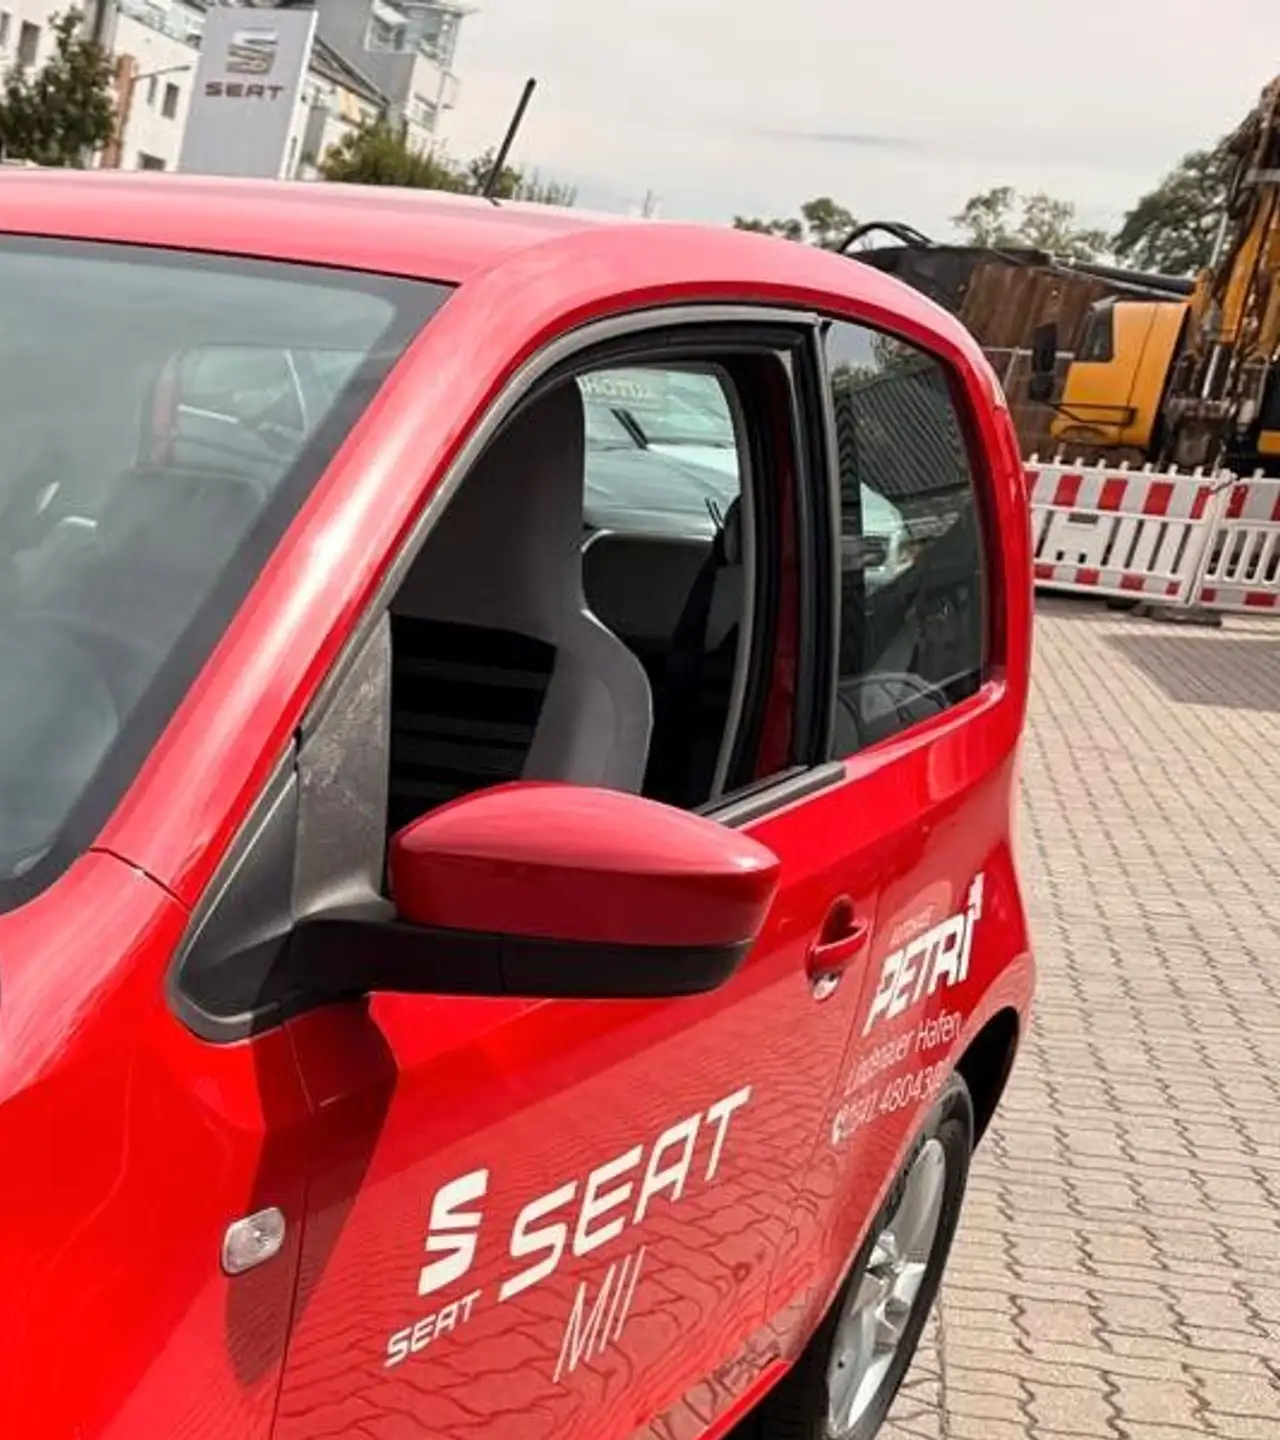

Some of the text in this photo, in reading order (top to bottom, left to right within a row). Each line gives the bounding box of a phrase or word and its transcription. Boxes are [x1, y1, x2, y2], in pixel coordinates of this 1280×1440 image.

[205, 81, 284, 101] SEAT
[861, 872, 984, 1037] PETRI
[915, 1008, 963, 1053] Hafen
[499, 1085, 752, 1302] SEAT
[384, 1288, 483, 1368] SEAT
